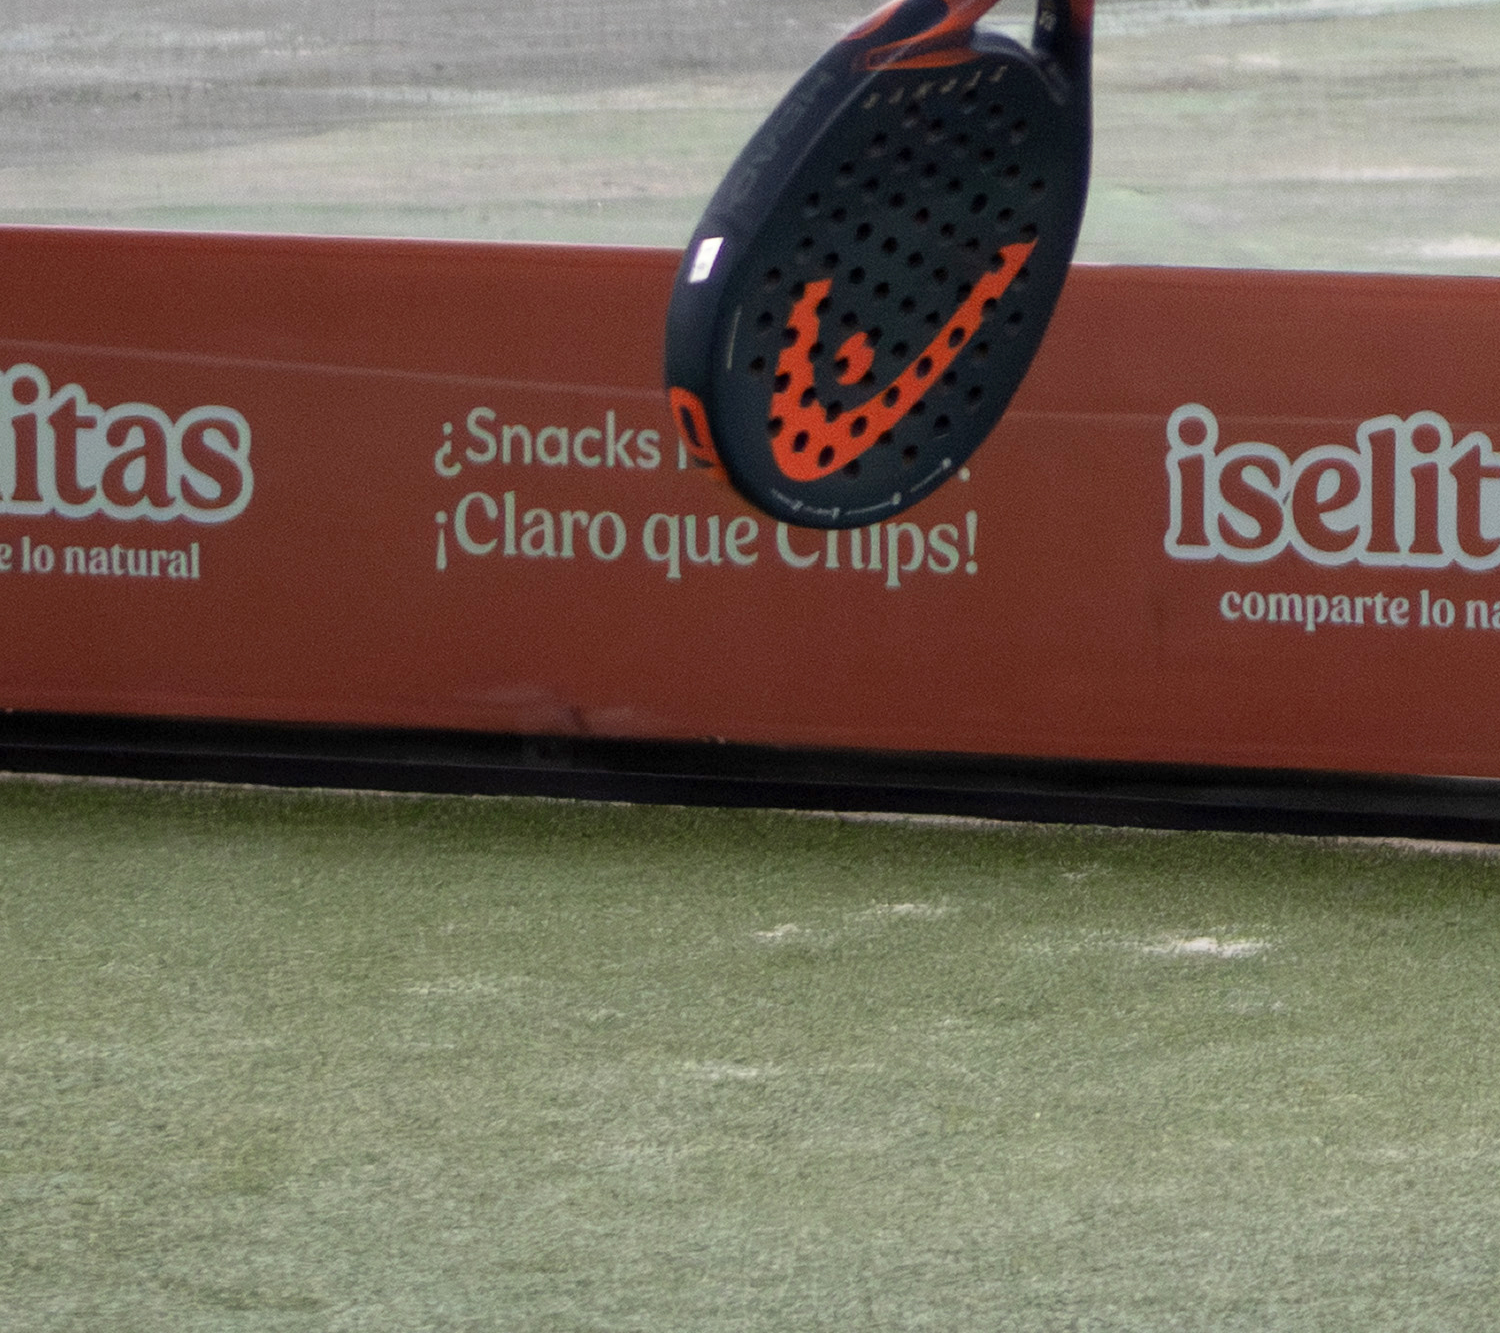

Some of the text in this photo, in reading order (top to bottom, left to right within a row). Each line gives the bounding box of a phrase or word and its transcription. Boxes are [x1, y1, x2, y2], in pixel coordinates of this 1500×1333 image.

[434, 407, 661, 477] ¿Snacks
[22, 536, 54, 573] lo
[64, 543, 199, 579] natural
[436, 491, 626, 570] ¡Claro
[643, 514, 758, 579] que
[1220, 591, 1409, 632] comparte
[1420, 590, 1455, 627] lo
